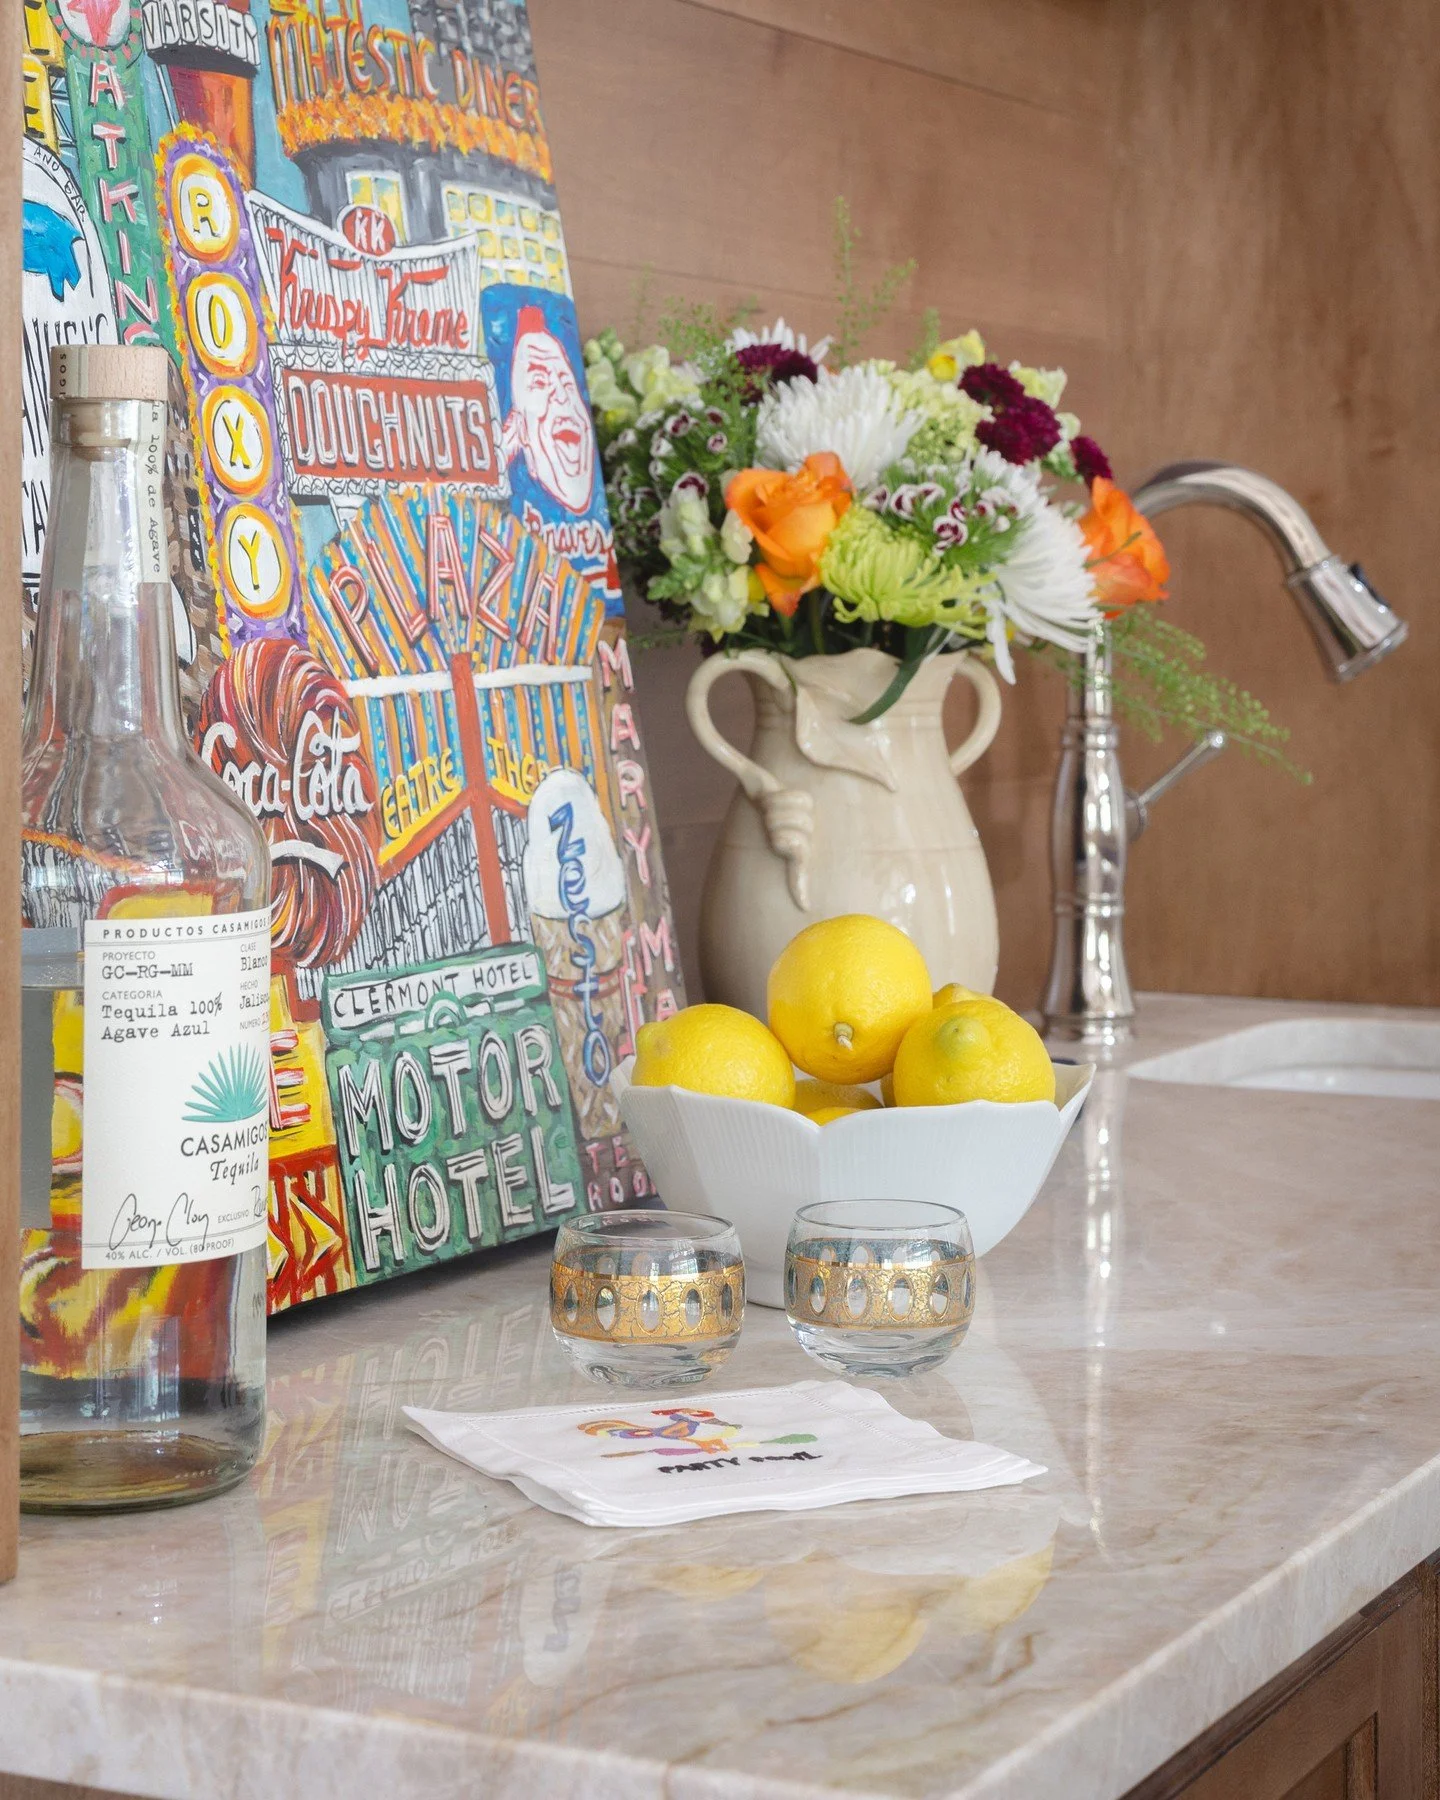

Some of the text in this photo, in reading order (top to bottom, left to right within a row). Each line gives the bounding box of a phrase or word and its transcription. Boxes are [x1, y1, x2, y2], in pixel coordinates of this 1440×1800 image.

[143, 1, 259, 66] VARSITY
[268, 14, 547, 137] MAJESTIC DINER
[34, 147, 60, 172] AND
[353, 212, 388, 252] KK
[288, 375, 491, 475] DOUGHNUTS
[144, 434, 160, 476] 100%
[147, 483, 157, 509] de
[148, 516, 161, 574] Agave
[328, 514, 558, 677] PLAZA
[201, 706, 375, 822] Coca-Cola
[103, 920, 266, 939] PRODUCTOS CASAMIGOS
[102, 951, 156, 961] PROYECTO
[240, 942, 256, 953] CLASE
[101, 963, 194, 979] GC-RG-MM
[240, 980, 258, 991] HECHO
[102, 990, 163, 1001] CATEGORIA
[333, 962, 534, 1018] CLERMONT HOTEL
[101, 992, 223, 1023] Tequila 100%
[101, 1020, 210, 1043] Agave Azul
[338, 1025, 562, 1156] MOTOR
[210, 1152, 259, 1185] Tequila
[354, 1127, 576, 1272] HOTEL
[217, 1209, 249, 1224] EXCLUSIVO
[105, 1251, 125, 1261] 40%
[129, 1249, 152, 1260] ALC.
[166, 1246, 187, 1256] VOL.
[206, 1238, 235, 1251] PROOF)
